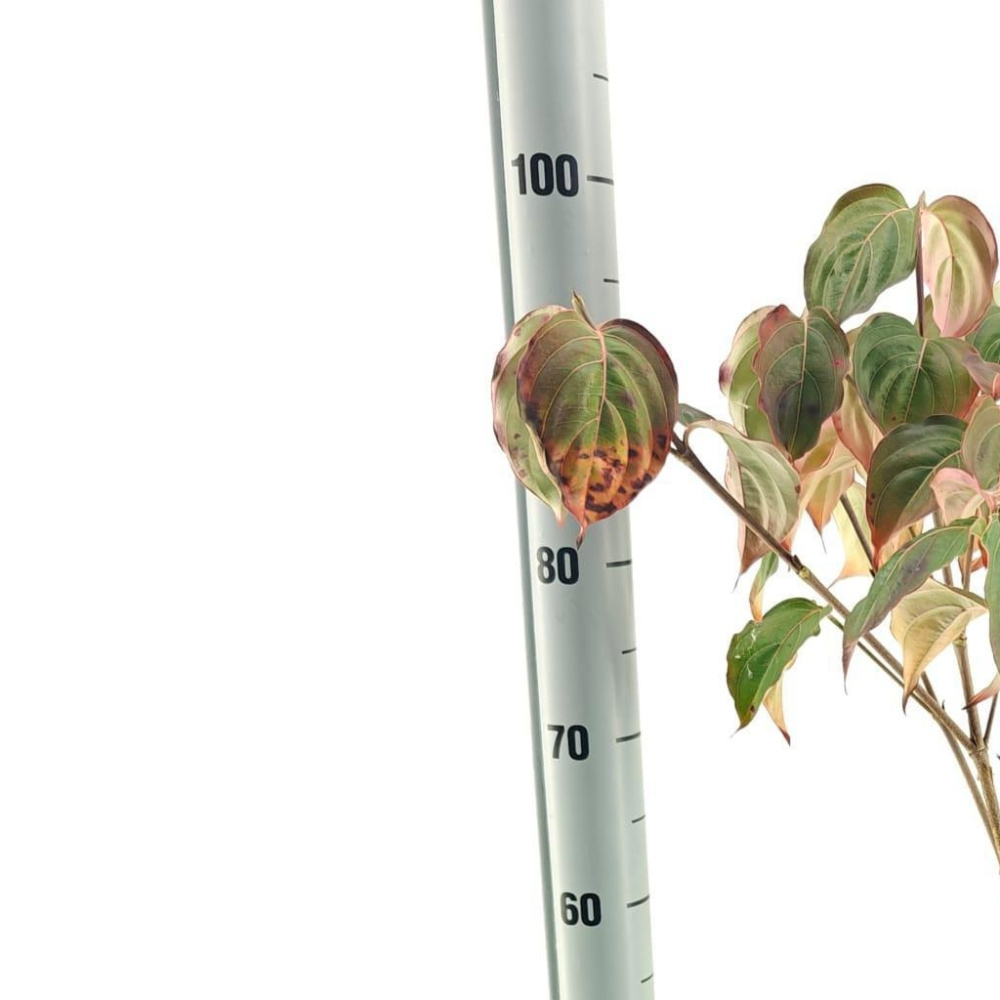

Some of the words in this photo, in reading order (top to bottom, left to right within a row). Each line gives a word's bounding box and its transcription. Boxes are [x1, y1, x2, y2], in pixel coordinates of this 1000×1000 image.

[511, 152, 579, 197] 100
[536, 546, 580, 585] 80
[547, 724, 590, 761] 70
[560, 892, 602, 927] 60
